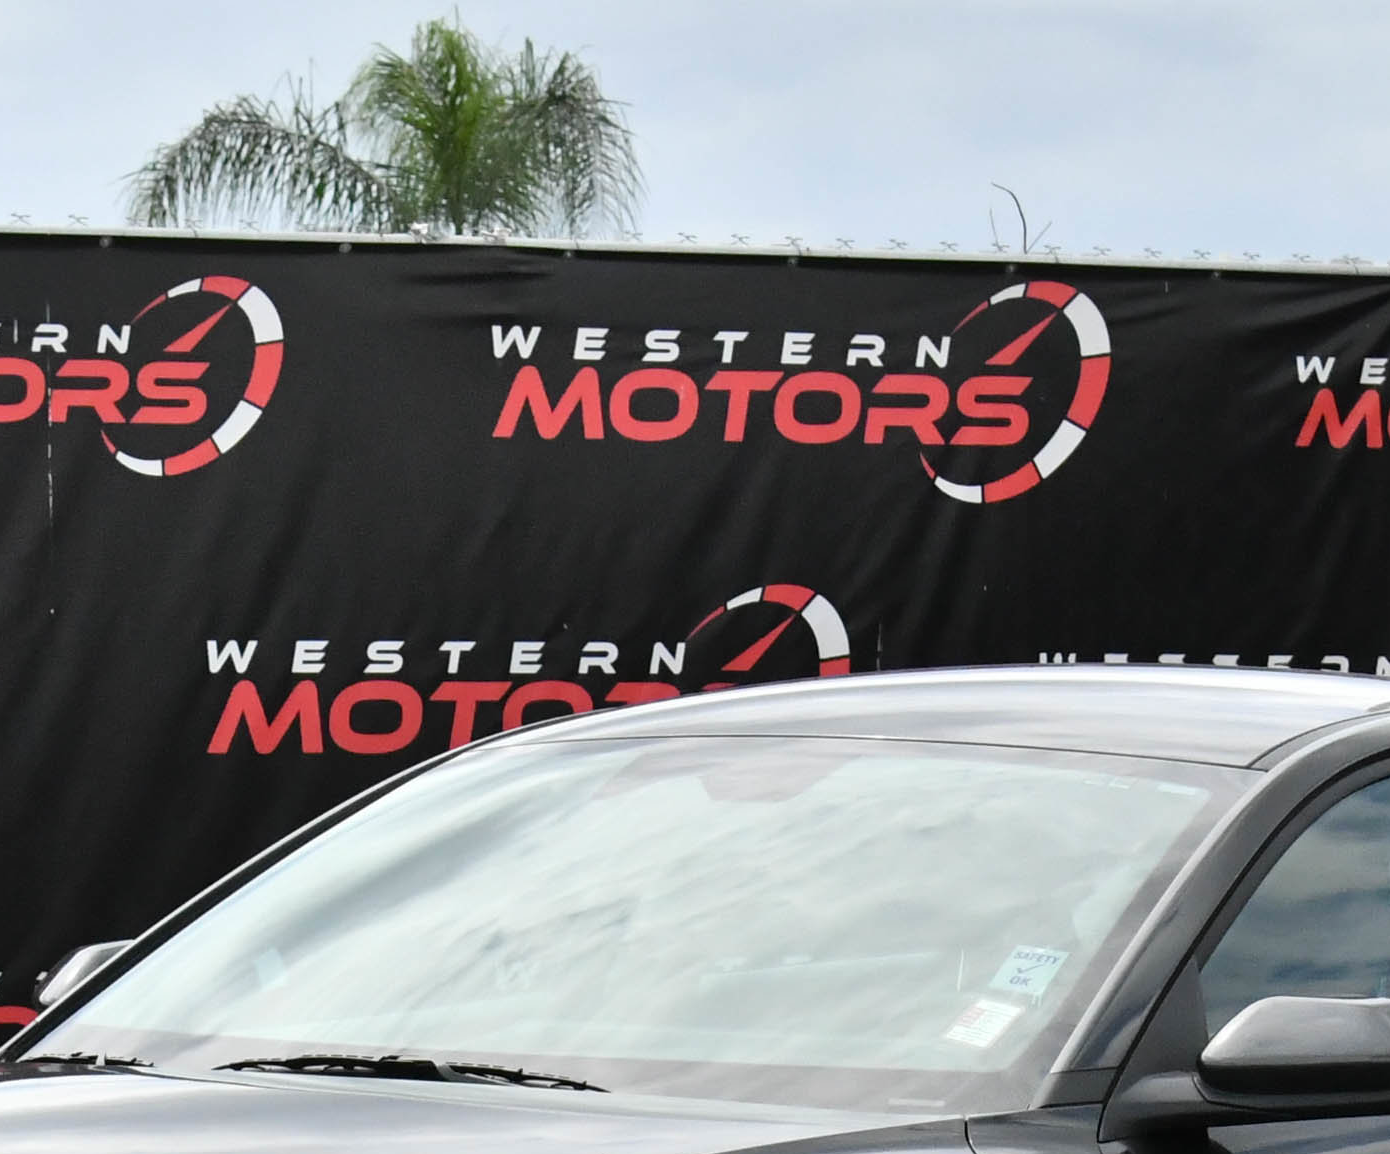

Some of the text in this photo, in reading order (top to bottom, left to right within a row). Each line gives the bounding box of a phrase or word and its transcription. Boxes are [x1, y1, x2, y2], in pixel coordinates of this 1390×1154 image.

[492, 325, 951, 368] WESTERN
[494, 366, 1033, 445] MOTORS
[207, 640, 685, 674] WESTERN
[1013, 952, 1060, 964] SAFETY
[1009, 975, 1033, 986] OK
